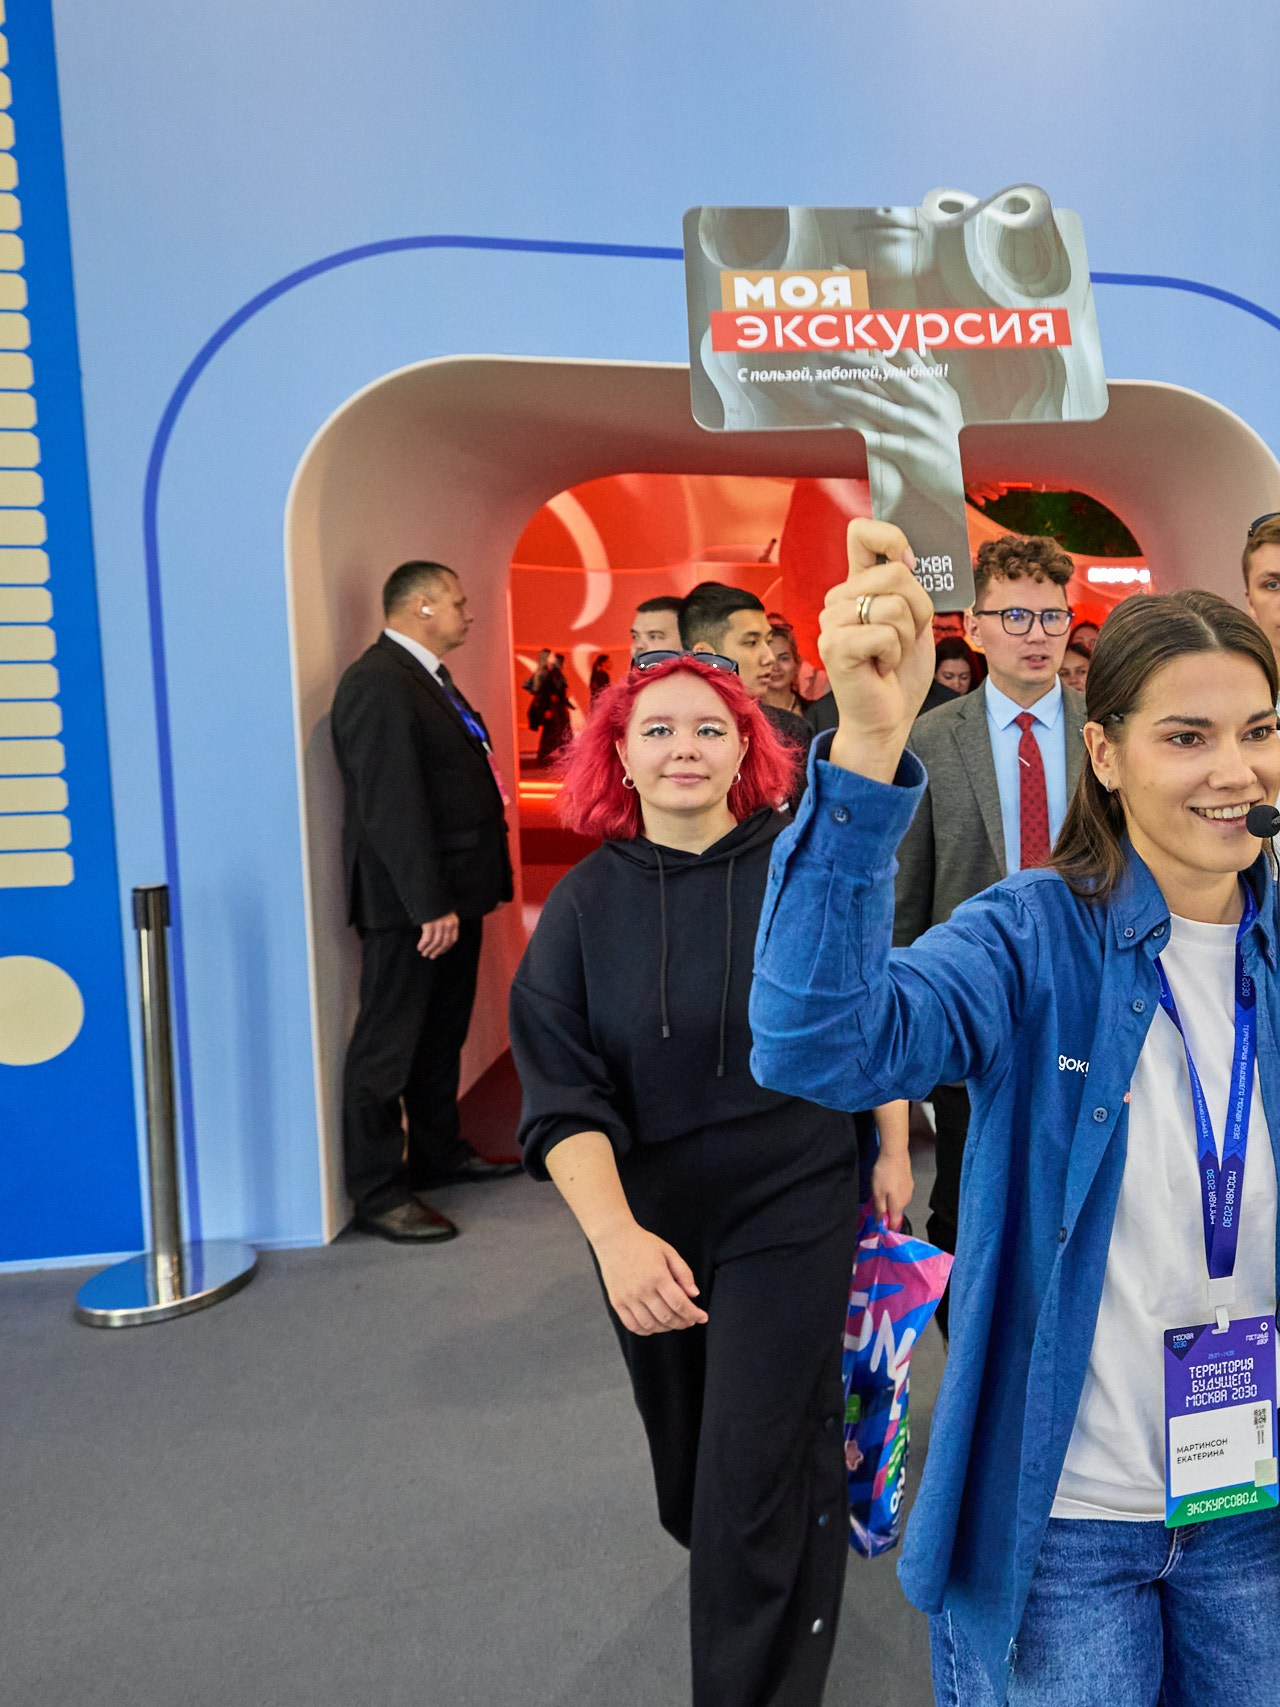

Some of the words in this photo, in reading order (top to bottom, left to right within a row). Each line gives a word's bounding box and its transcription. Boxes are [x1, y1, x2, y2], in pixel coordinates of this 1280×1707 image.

[737, 367, 748, 383] С
[750, 366, 814, 383] пользой,
[815, 364, 882, 382] заботой,
[912, 555, 953, 574] СКВА
[1225, 1170, 1237, 1204] МОСКВА
[1222, 1205, 1233, 1228] 2030
[1188, 1357, 1254, 1379] ТЕРРИТОРИЯ
[1192, 1372, 1251, 1393] БУДУЩЕГО
[1185, 1389, 1228, 1408] МОСКВА
[1231, 1384, 1257, 1400] 2030
[1176, 1438, 1228, 1454] МАРТИНСОН
[1177, 1449, 1225, 1465] ЕКАТЕРИНА
[1186, 1490, 1259, 1517] ЭКСКУРСОВОД
